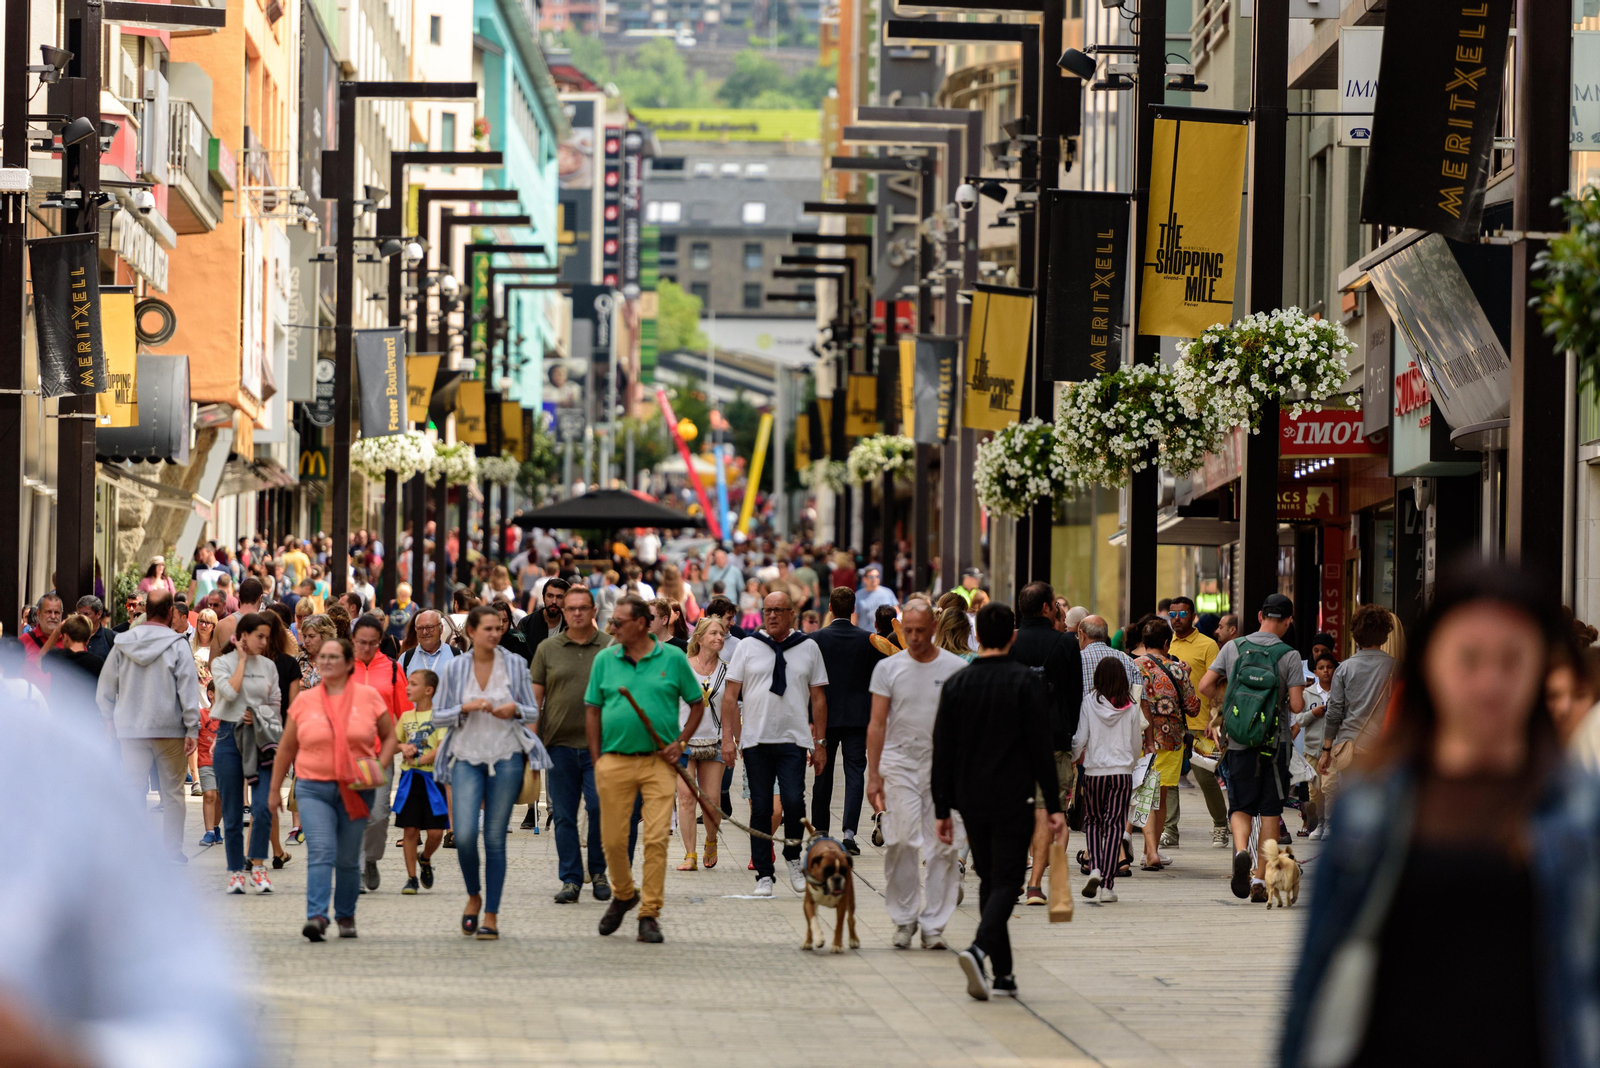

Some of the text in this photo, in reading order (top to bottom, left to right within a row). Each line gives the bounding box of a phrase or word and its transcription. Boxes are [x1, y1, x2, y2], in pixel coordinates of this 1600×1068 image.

[1438, 2, 1489, 219] MERITXELL
[1155, 249, 1224, 278] SHOPPING
[1159, 213, 1183, 249] THE
[71, 266, 95, 387] MERITXELL
[287, 266, 301, 361] LONGINES
[1089, 229, 1116, 372] MERITXELL
[1185, 276, 1217, 303] MILE
[115, 389, 130, 404] MILE
[383, 336, 399, 432] Fener Boulevard
[937, 357, 953, 440] MERITXELL
